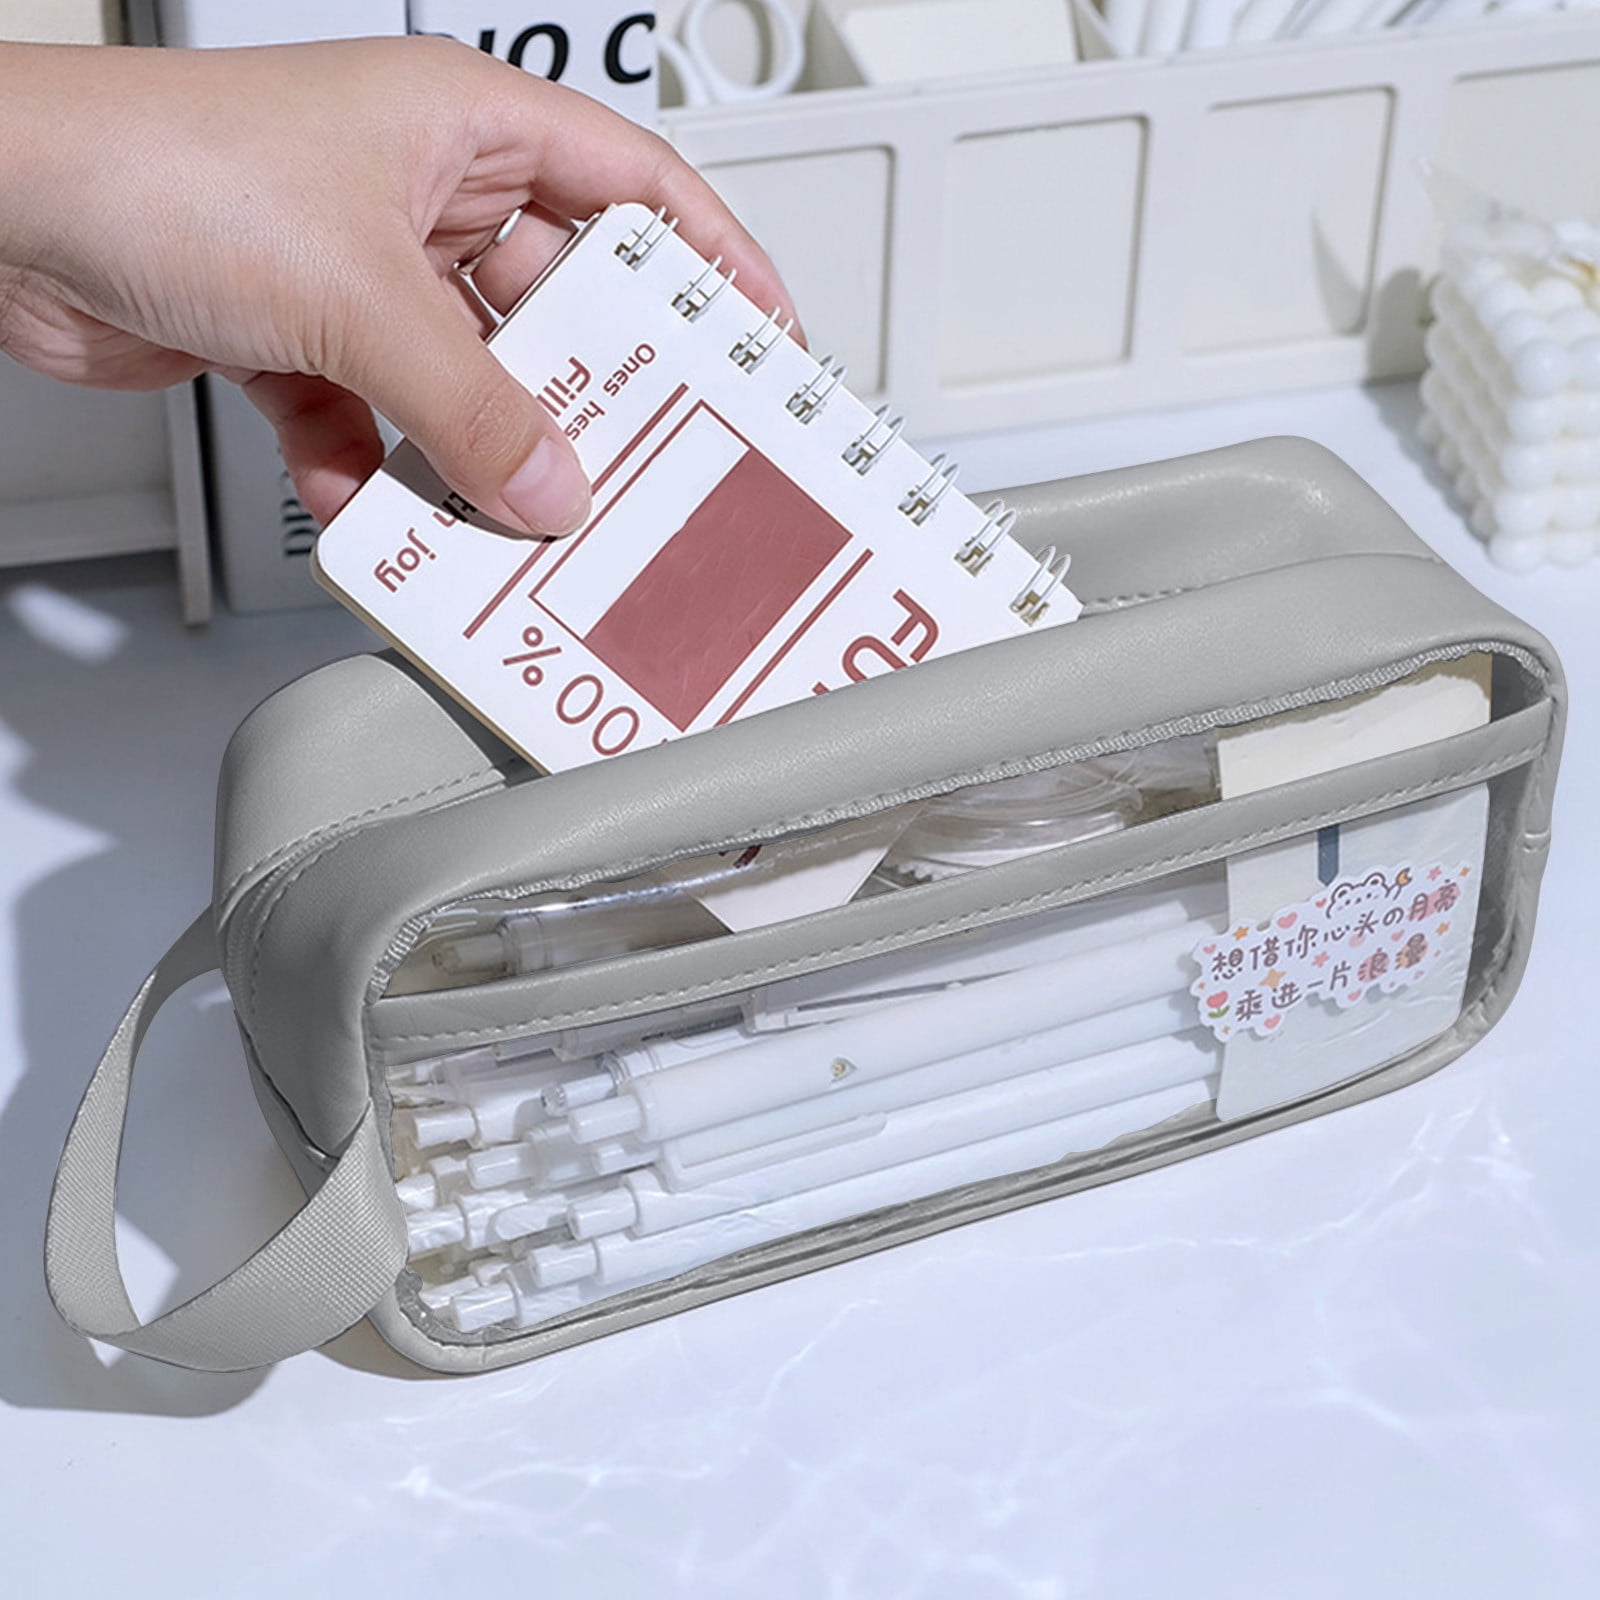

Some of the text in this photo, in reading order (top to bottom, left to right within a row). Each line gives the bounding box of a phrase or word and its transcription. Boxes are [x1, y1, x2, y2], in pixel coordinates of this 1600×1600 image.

[603, 343, 656, 397] Ones
[374, 527, 436, 593] joy
[812, 588, 939, 695] FU
